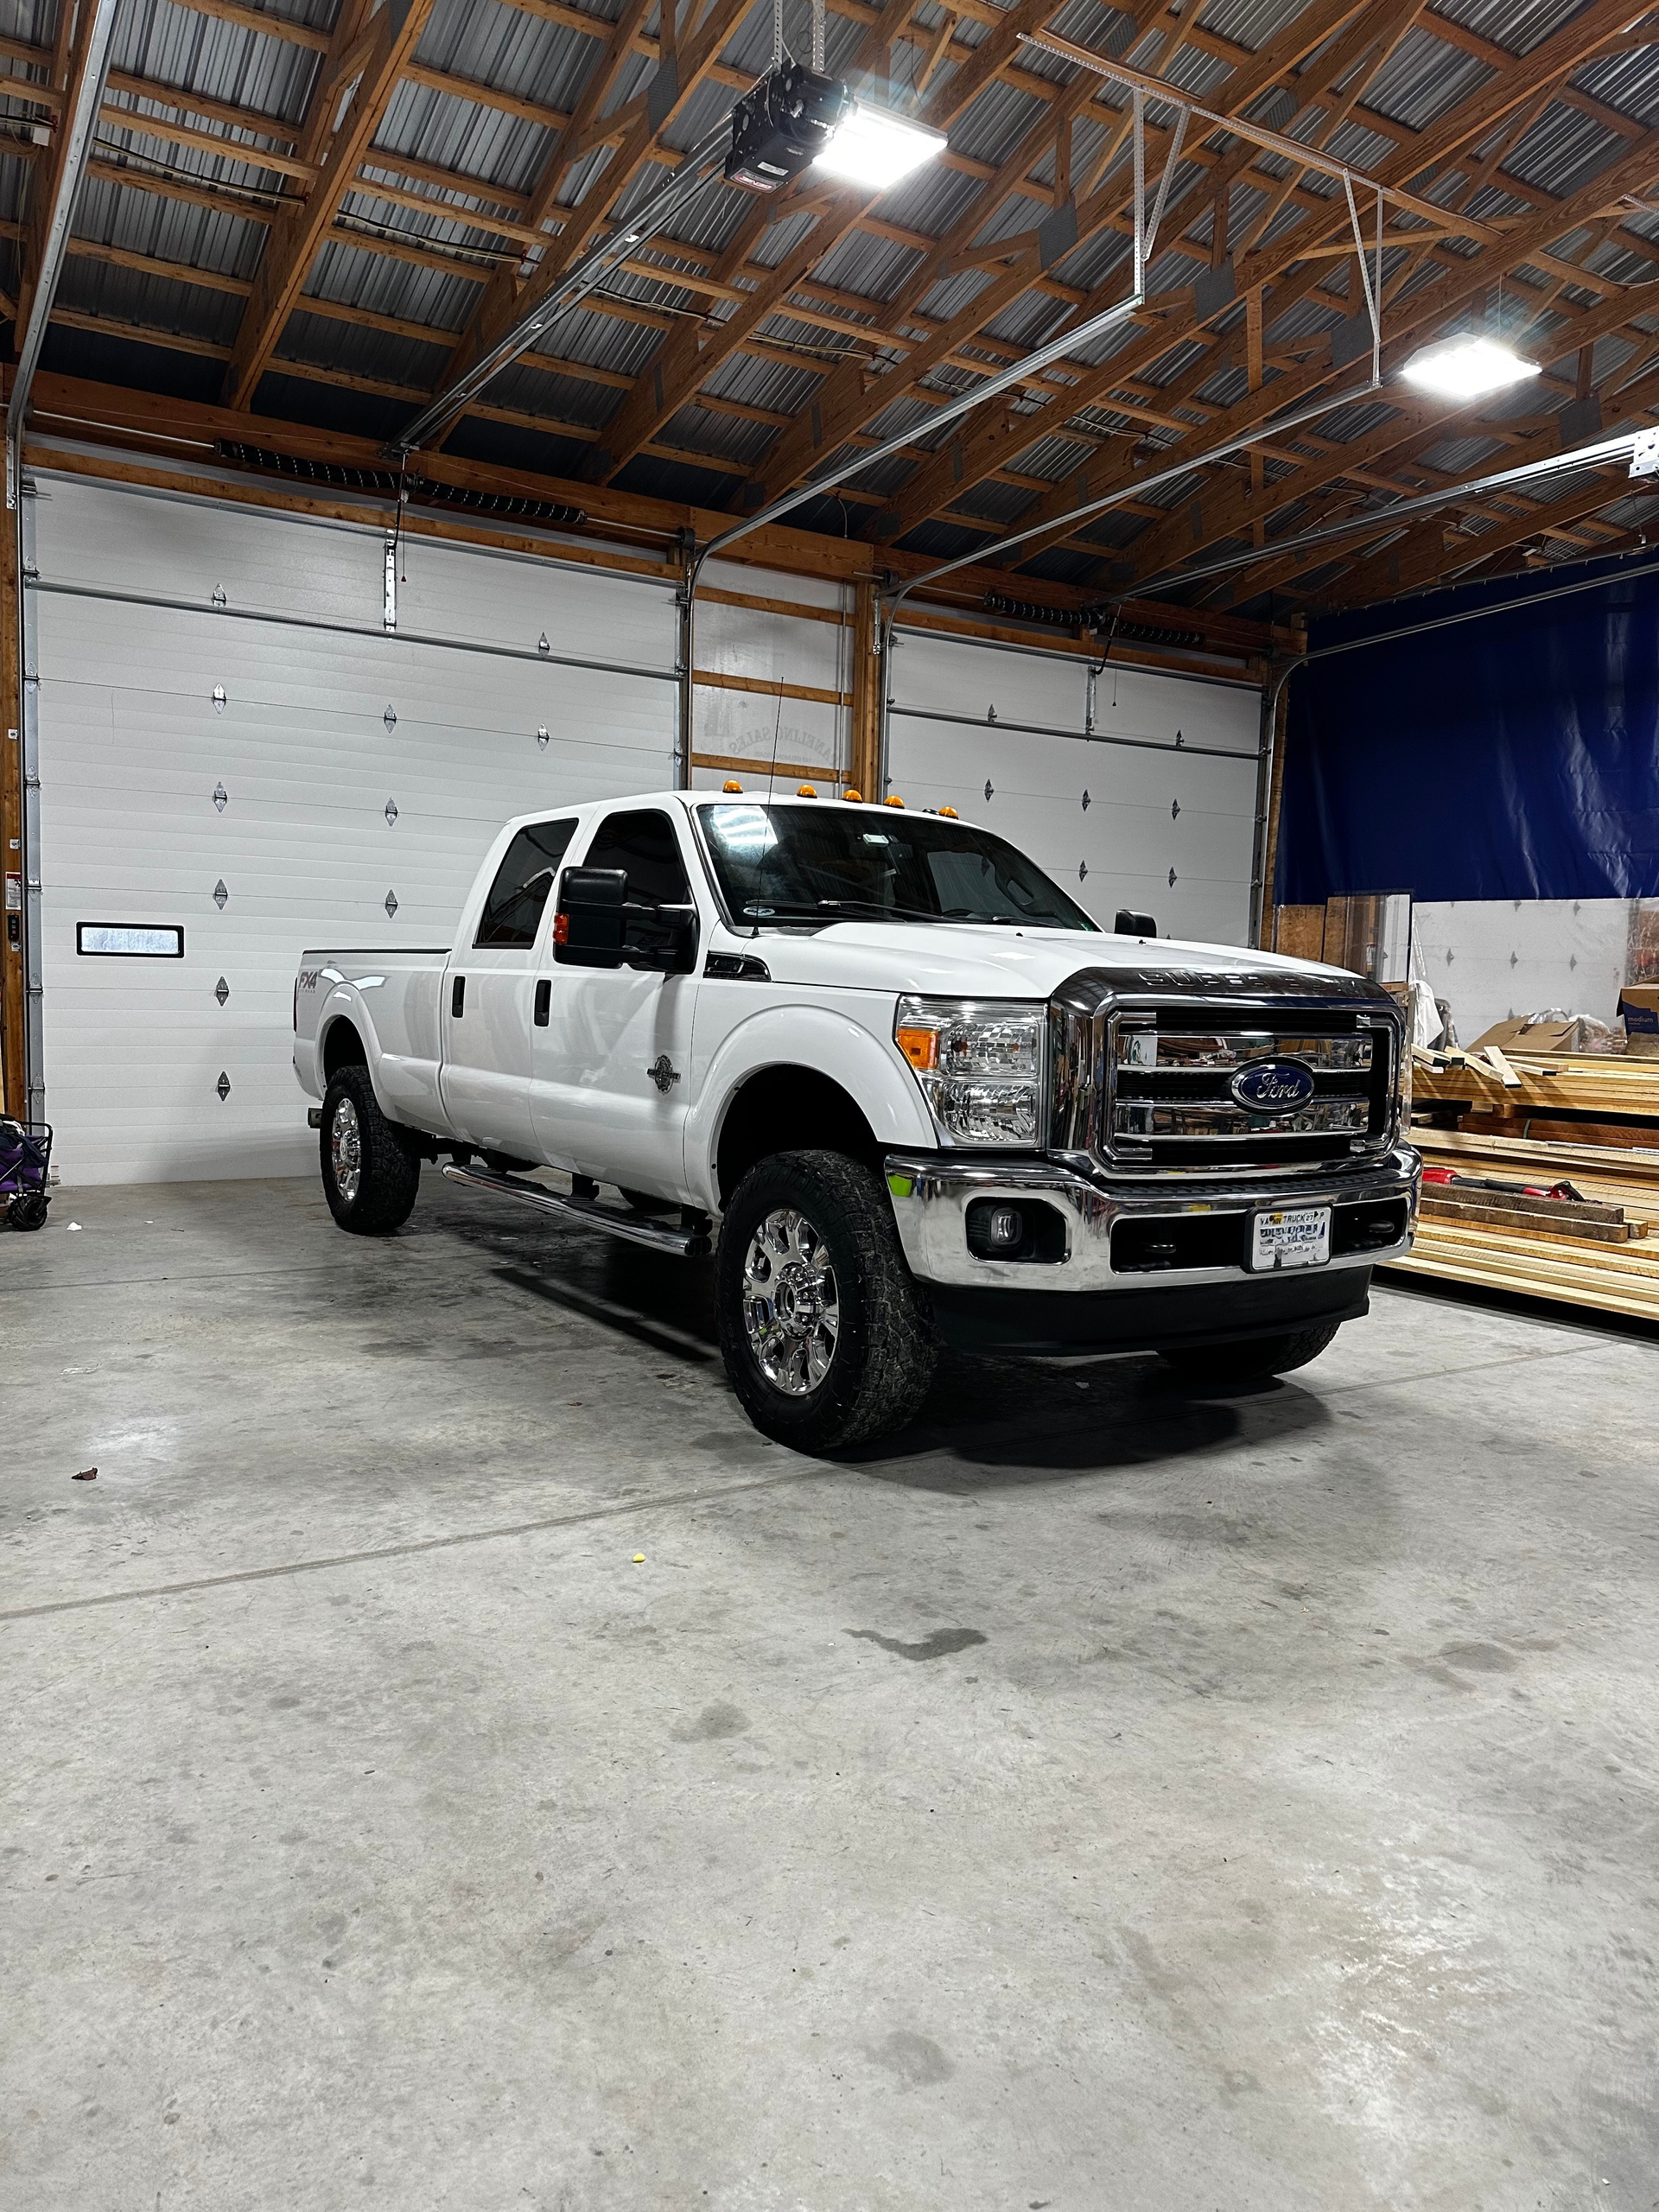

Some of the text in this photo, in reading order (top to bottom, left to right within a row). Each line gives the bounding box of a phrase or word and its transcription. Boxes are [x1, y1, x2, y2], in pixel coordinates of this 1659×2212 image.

[298, 971, 318, 988] FX4
[1138, 971, 1271, 989] SUPER
[1256, 1072, 1301, 1098] Ford
[1260, 1217, 1269, 1225] VA
[1283, 1213, 1306, 1224] TRUCK
